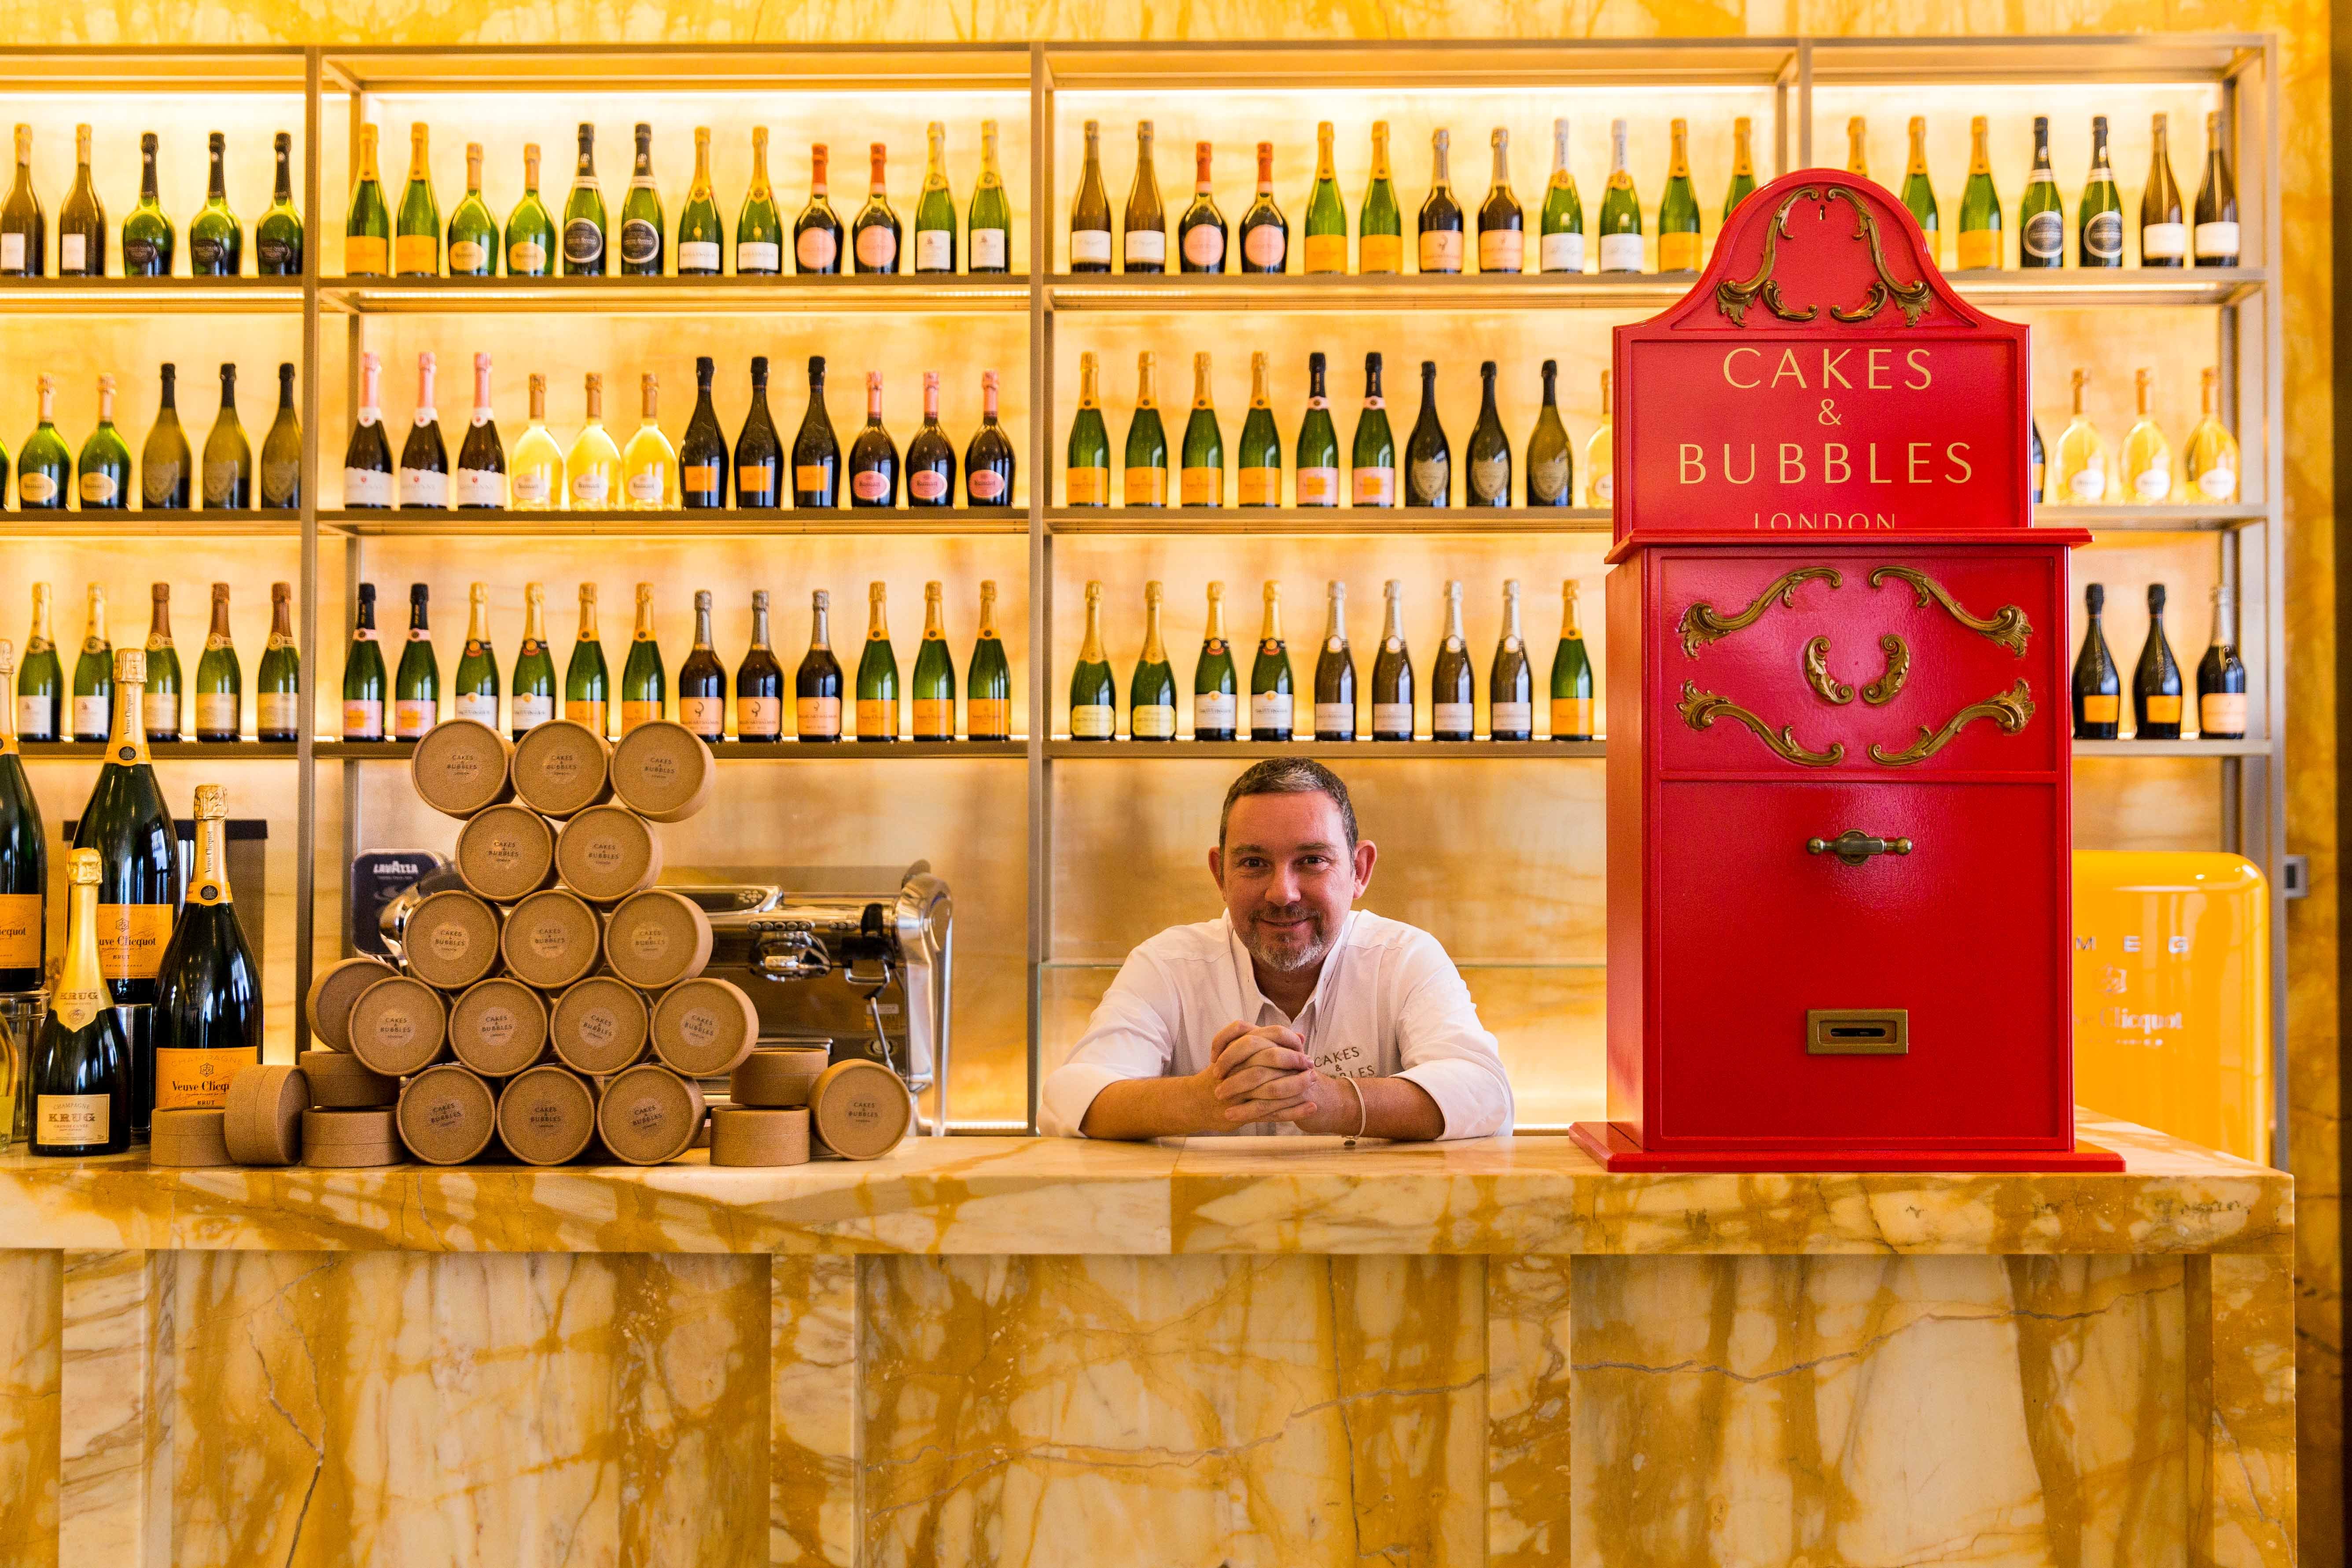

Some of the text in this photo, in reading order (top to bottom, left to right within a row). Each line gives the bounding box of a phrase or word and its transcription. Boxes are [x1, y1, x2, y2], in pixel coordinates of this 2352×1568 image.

[1723, 348, 1932, 390] CAKES
[1818, 399, 1842, 425] &
[1679, 442, 1972, 484] BUBBLES
[205, 831, 213, 854] Clicquot
[118, 935, 156, 947] Clicquot
[2076, 935, 2189, 953] MEG
[592, 1015, 611, 1027] CAKES
[692, 1015, 712, 1025] CAKES
[2099, 1007, 2183, 1034] Clicquot
[584, 1022, 611, 1036] BUBBLES
[685, 1022, 713, 1036] BUBBLES
[1314, 1047, 1360, 1067] CAKES
[173, 1081, 199, 1091] Veuve
[634, 1105, 656, 1115] CAKES
[48, 1113, 95, 1122] KRUG
[633, 1114, 662, 1125] BUBBLES
